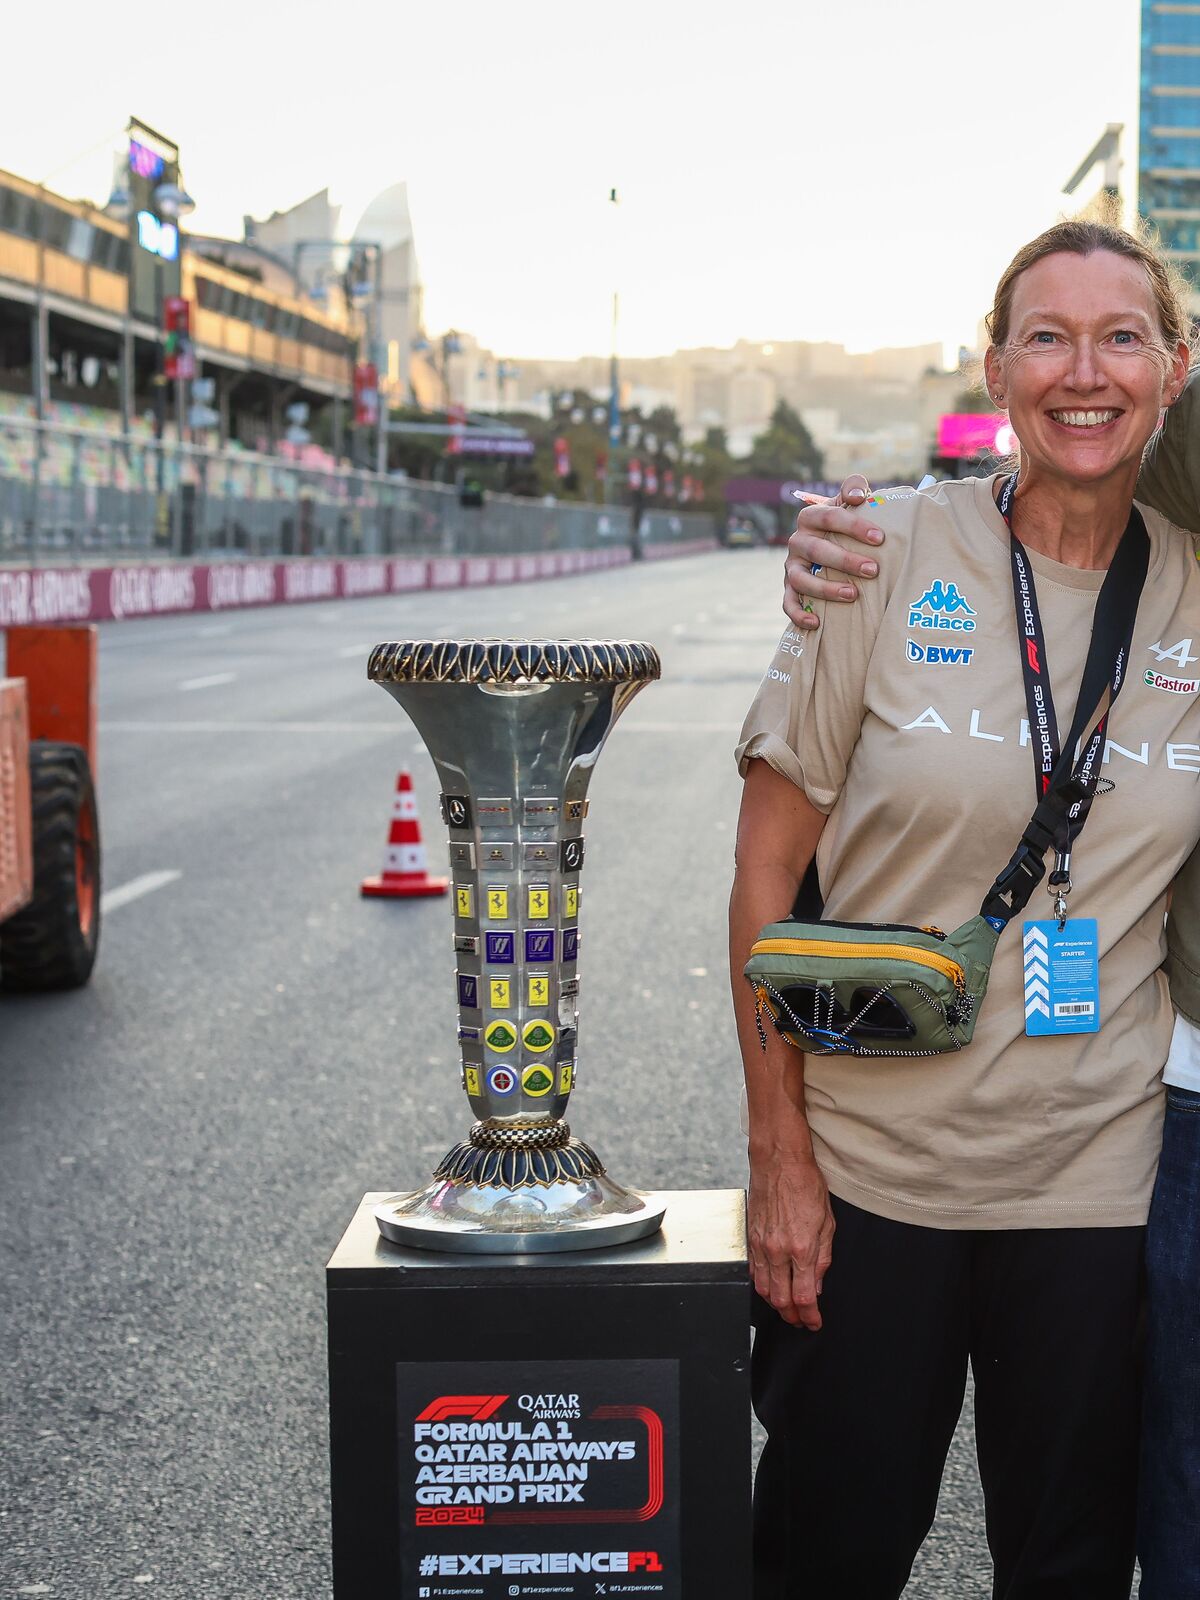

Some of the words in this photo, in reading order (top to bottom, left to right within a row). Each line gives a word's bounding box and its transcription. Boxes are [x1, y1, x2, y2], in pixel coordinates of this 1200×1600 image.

[1015, 551, 1036, 636] Experiences
[908, 612, 976, 632] Palace
[924, 644, 975, 665] BWT
[1154, 673, 1196, 692] Castrol
[1034, 684, 1053, 773] Experiences
[517, 1394, 580, 1411] QATAR
[532, 1409, 581, 1419] AIRWAYS
[414, 1421, 552, 1442] FORMULA
[557, 1421, 572, 1440] 1
[414, 1443, 508, 1463] QATAR
[511, 1441, 636, 1461] AIRWAYS
[414, 1462, 588, 1484] AZERBAIJAN
[415, 1485, 515, 1505] GRAND
[518, 1483, 586, 1503] PRIX
[416, 1507, 484, 1525] 2024
[419, 1551, 663, 1576] #EXPERIENCEF1
[443, 1587, 484, 1595] Experiences
